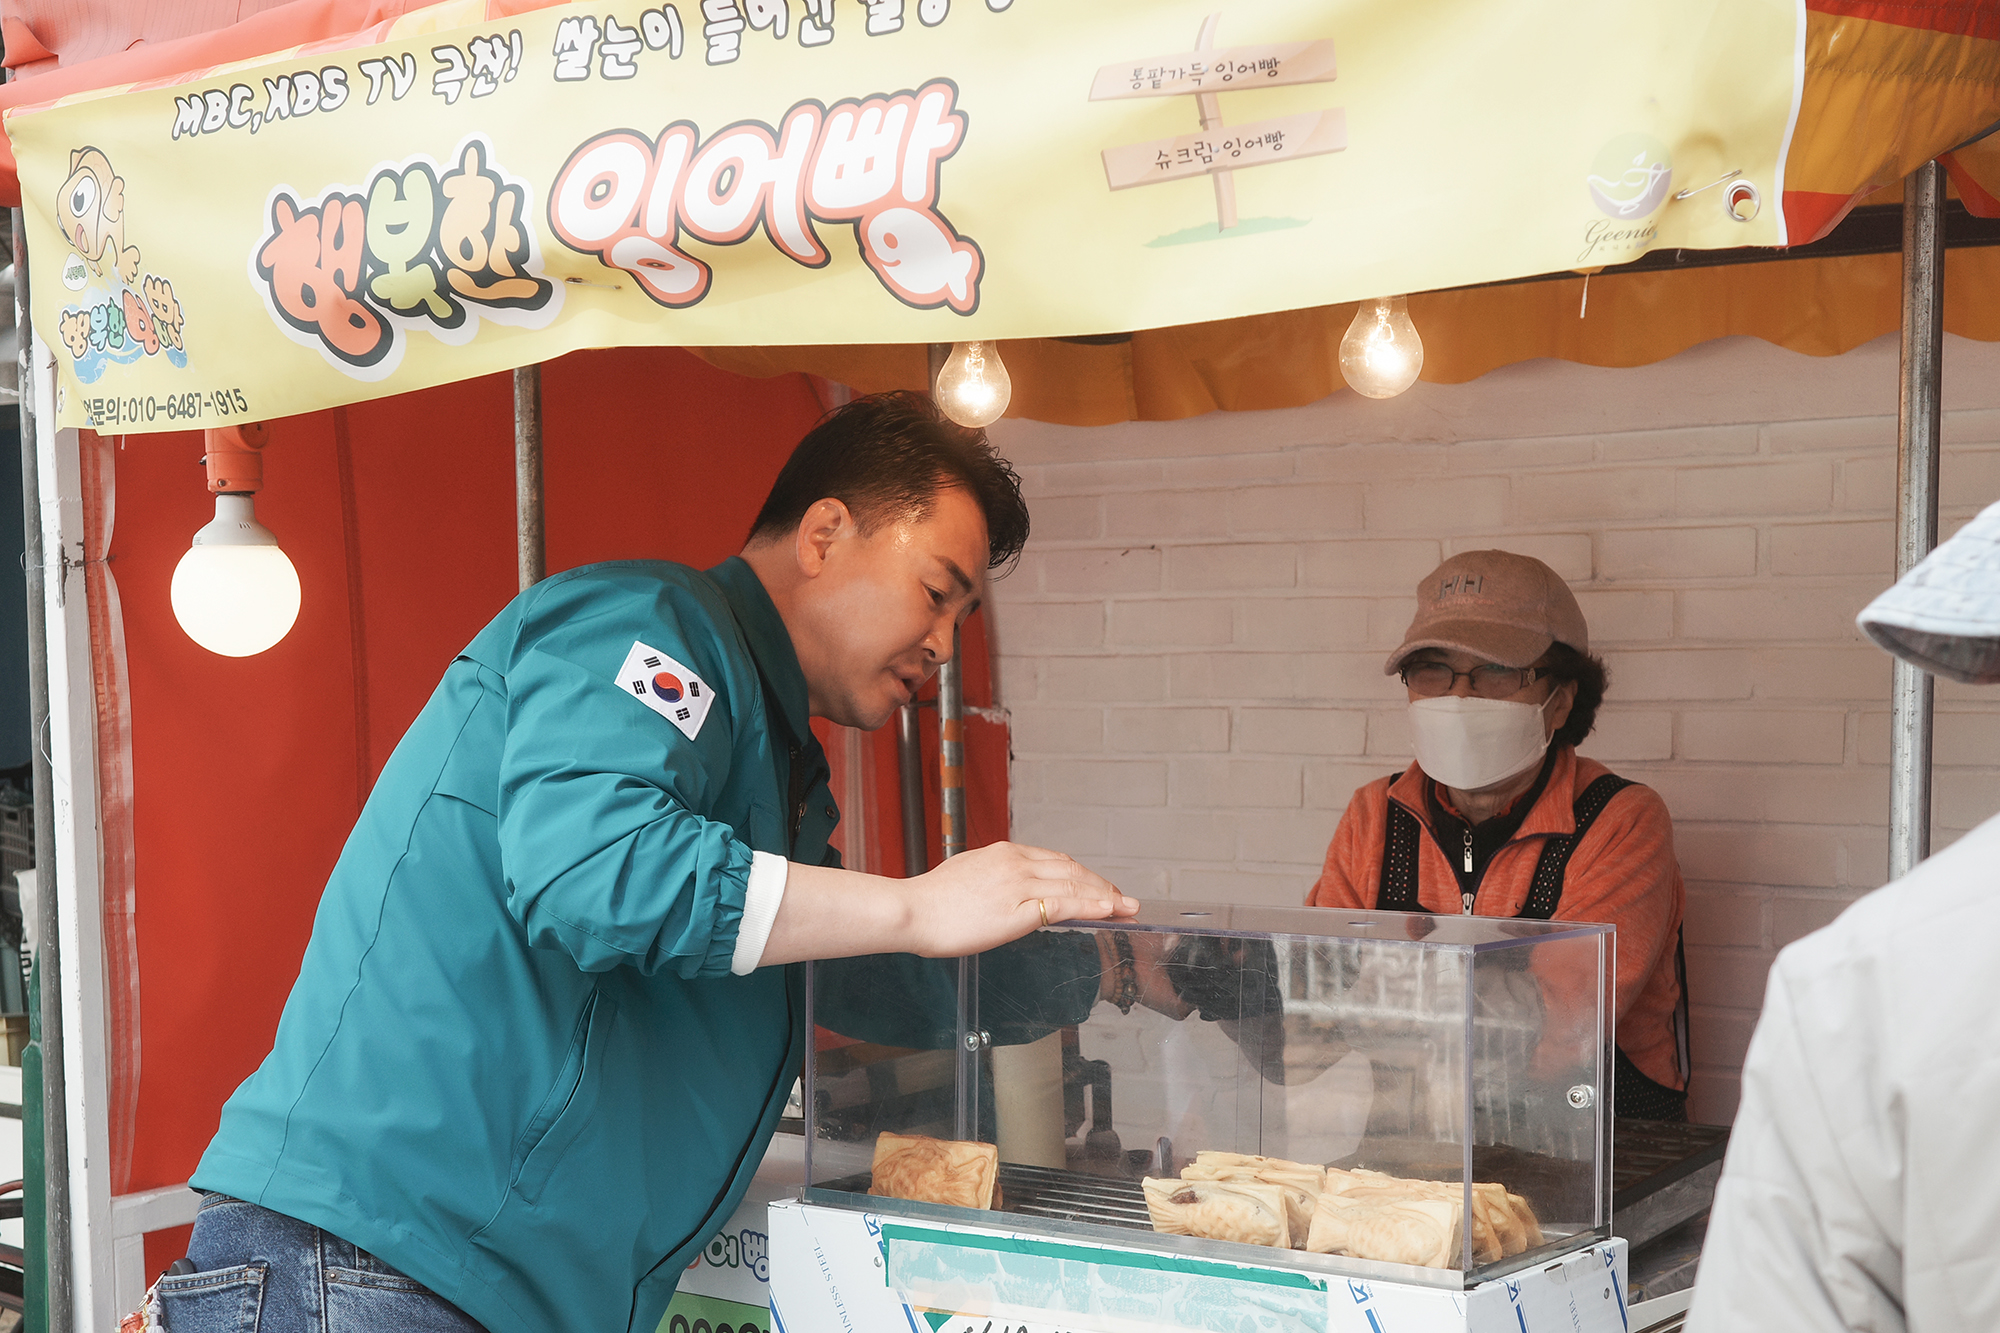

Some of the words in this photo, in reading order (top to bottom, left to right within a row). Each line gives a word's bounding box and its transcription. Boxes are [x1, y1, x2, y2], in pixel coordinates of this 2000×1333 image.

[358, 51, 417, 105] TV
[431, 28, 523, 105] 극찬!
[552, 3, 684, 81] 쌀눈이
[1129, 62, 1206, 90] 통팥가득
[1214, 56, 1282, 82] 잉어빵
[1155, 141, 1214, 170] 슈크림
[1222, 130, 1286, 158] 잉어빵
[257, 139, 553, 367] 행복한
[546, 77, 985, 317] 잉어빵
[60, 296, 125, 359] 행복한
[1440, 574, 1483, 600] HH
[813, 1246, 834, 1283] STEEL
